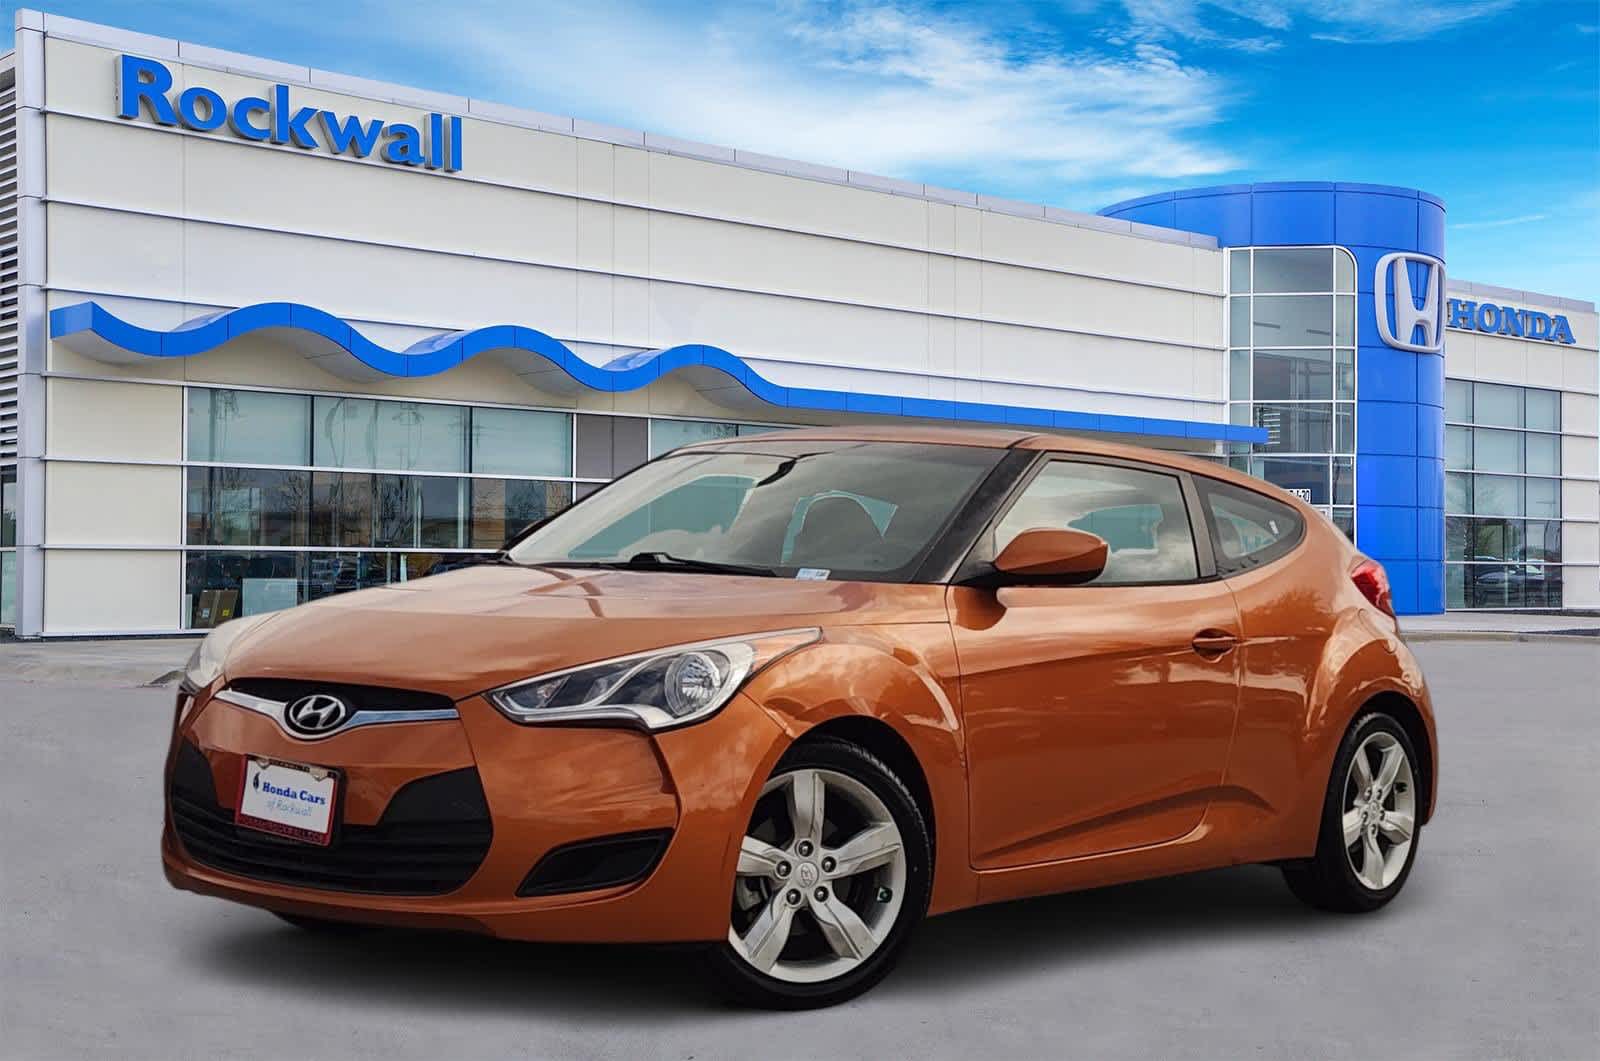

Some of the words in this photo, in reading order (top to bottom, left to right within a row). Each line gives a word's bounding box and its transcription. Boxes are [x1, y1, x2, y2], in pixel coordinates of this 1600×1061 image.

[116, 54, 463, 172] Rockwall
[1447, 298, 1576, 344] HONDA
[262, 782, 297, 799] Honda
[299, 790, 326, 805] Cars
